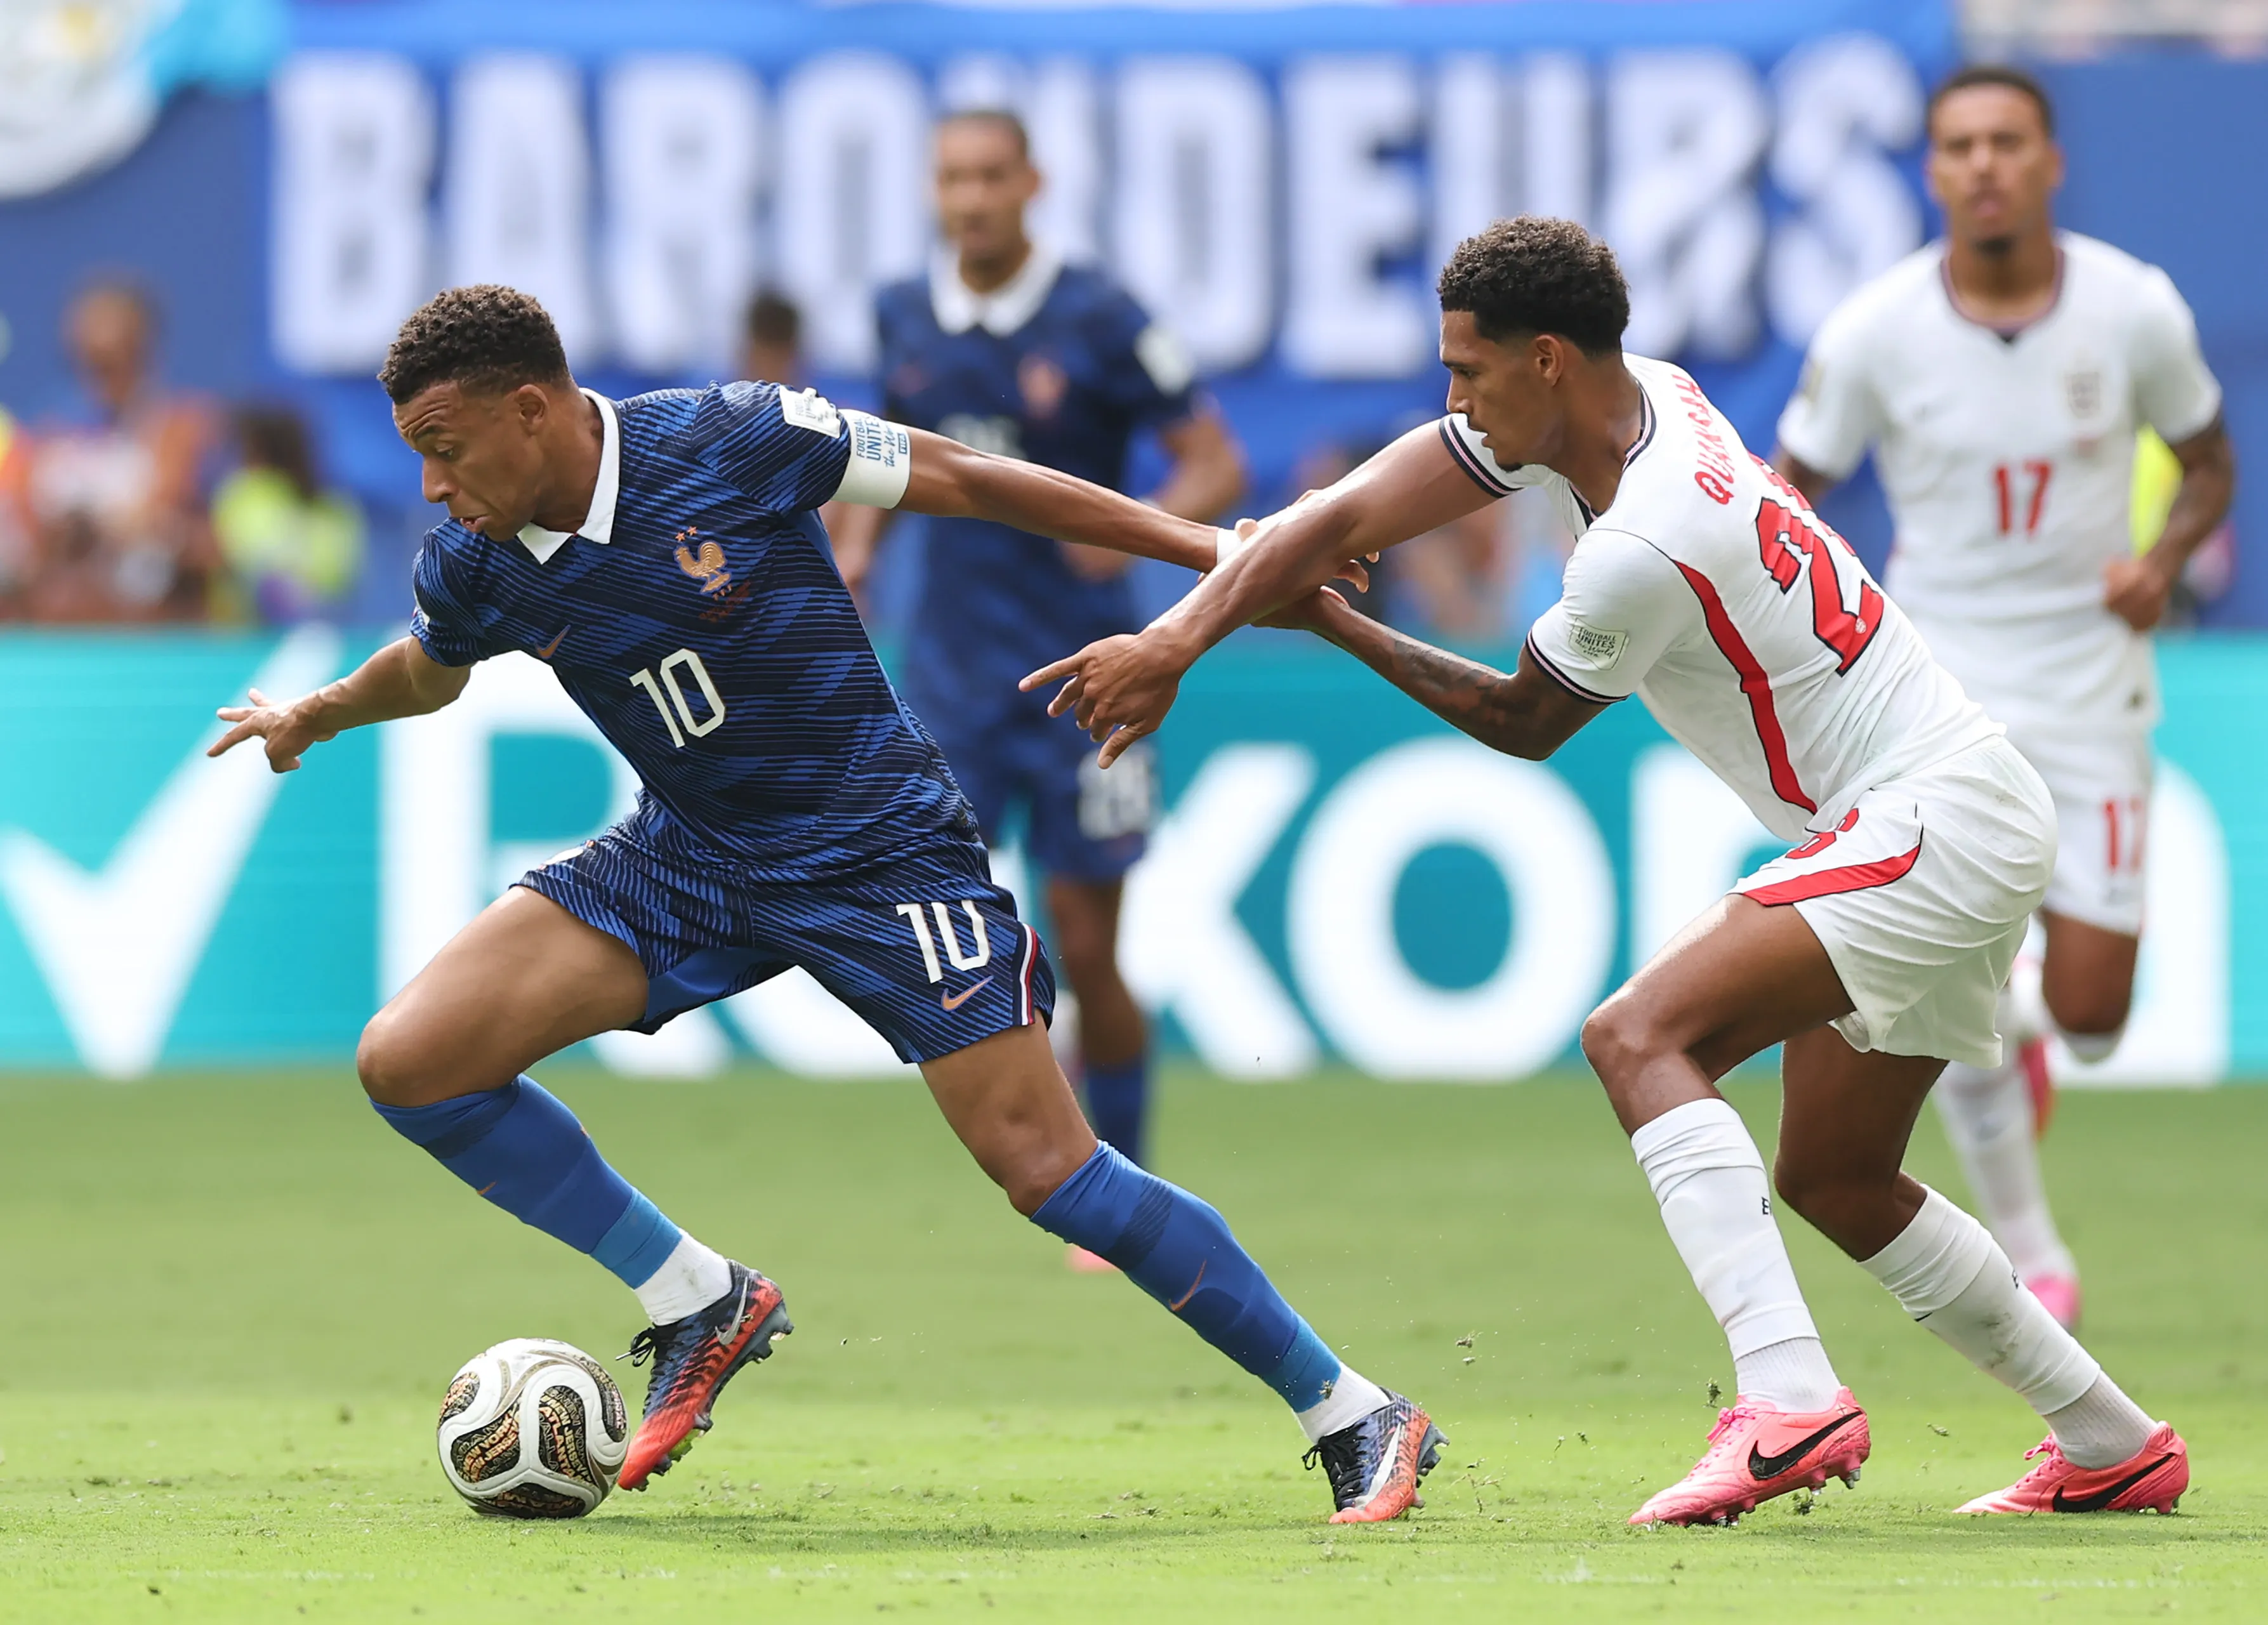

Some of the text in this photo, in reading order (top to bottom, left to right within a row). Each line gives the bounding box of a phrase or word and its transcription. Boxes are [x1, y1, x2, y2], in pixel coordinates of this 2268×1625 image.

[1991, 459, 2052, 541] 17
[1578, 632, 1616, 649] UNITES
[1579, 626, 1616, 641] FOOTBALL
[628, 647, 726, 749] 10
[538, 1406, 576, 1478] ATLANTA
